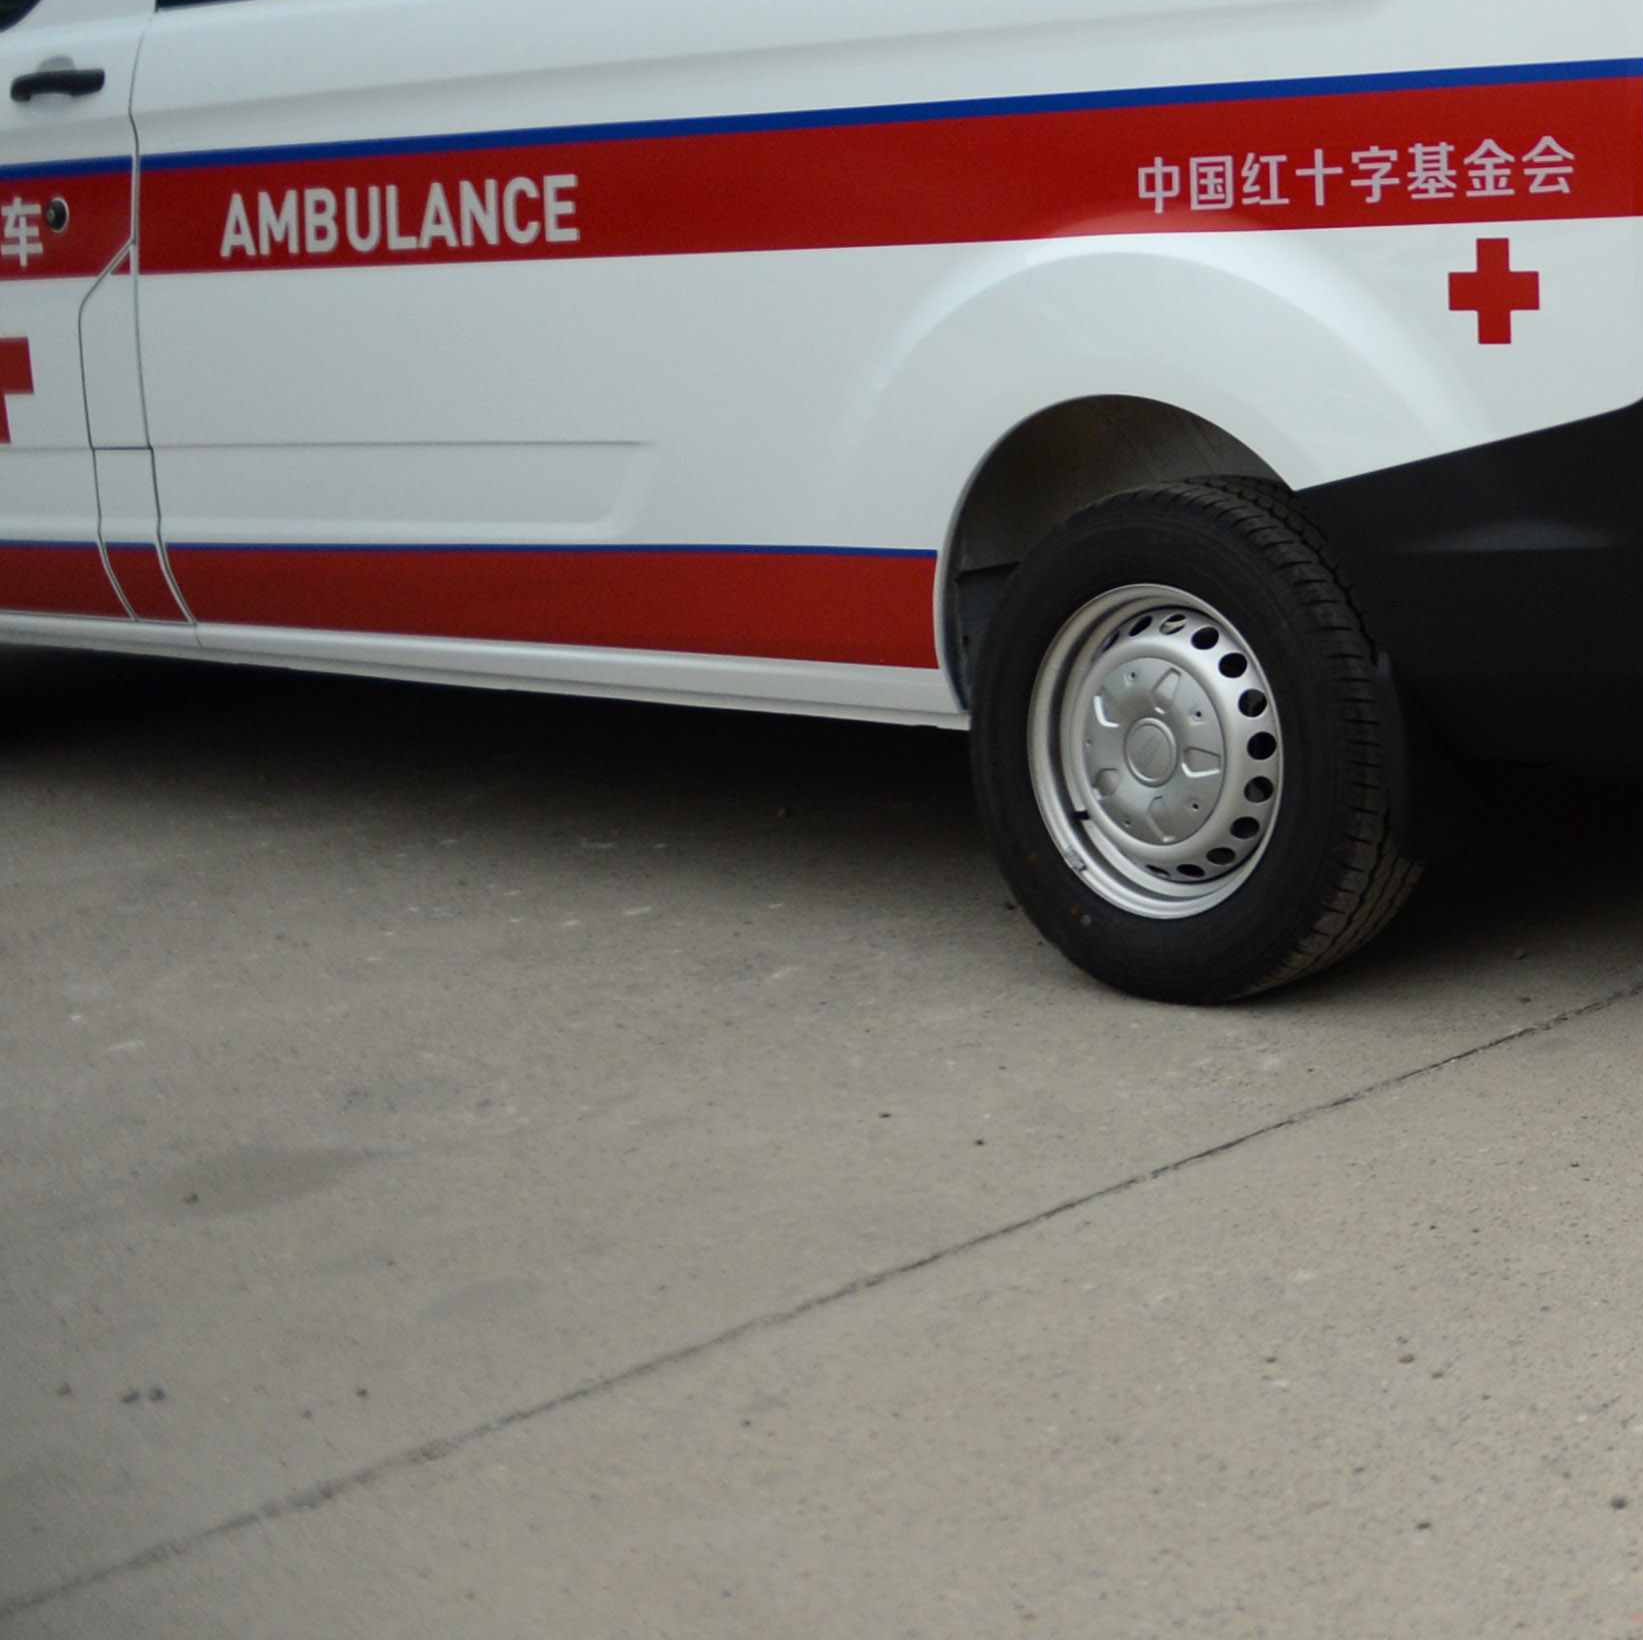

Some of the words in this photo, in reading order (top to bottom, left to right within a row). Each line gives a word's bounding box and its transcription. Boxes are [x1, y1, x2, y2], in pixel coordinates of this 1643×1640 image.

[1137, 135, 1576, 215] 中国红十字基金会
[0, 196, 44, 266] 车
[220, 173, 581, 258] AMBULANCE
